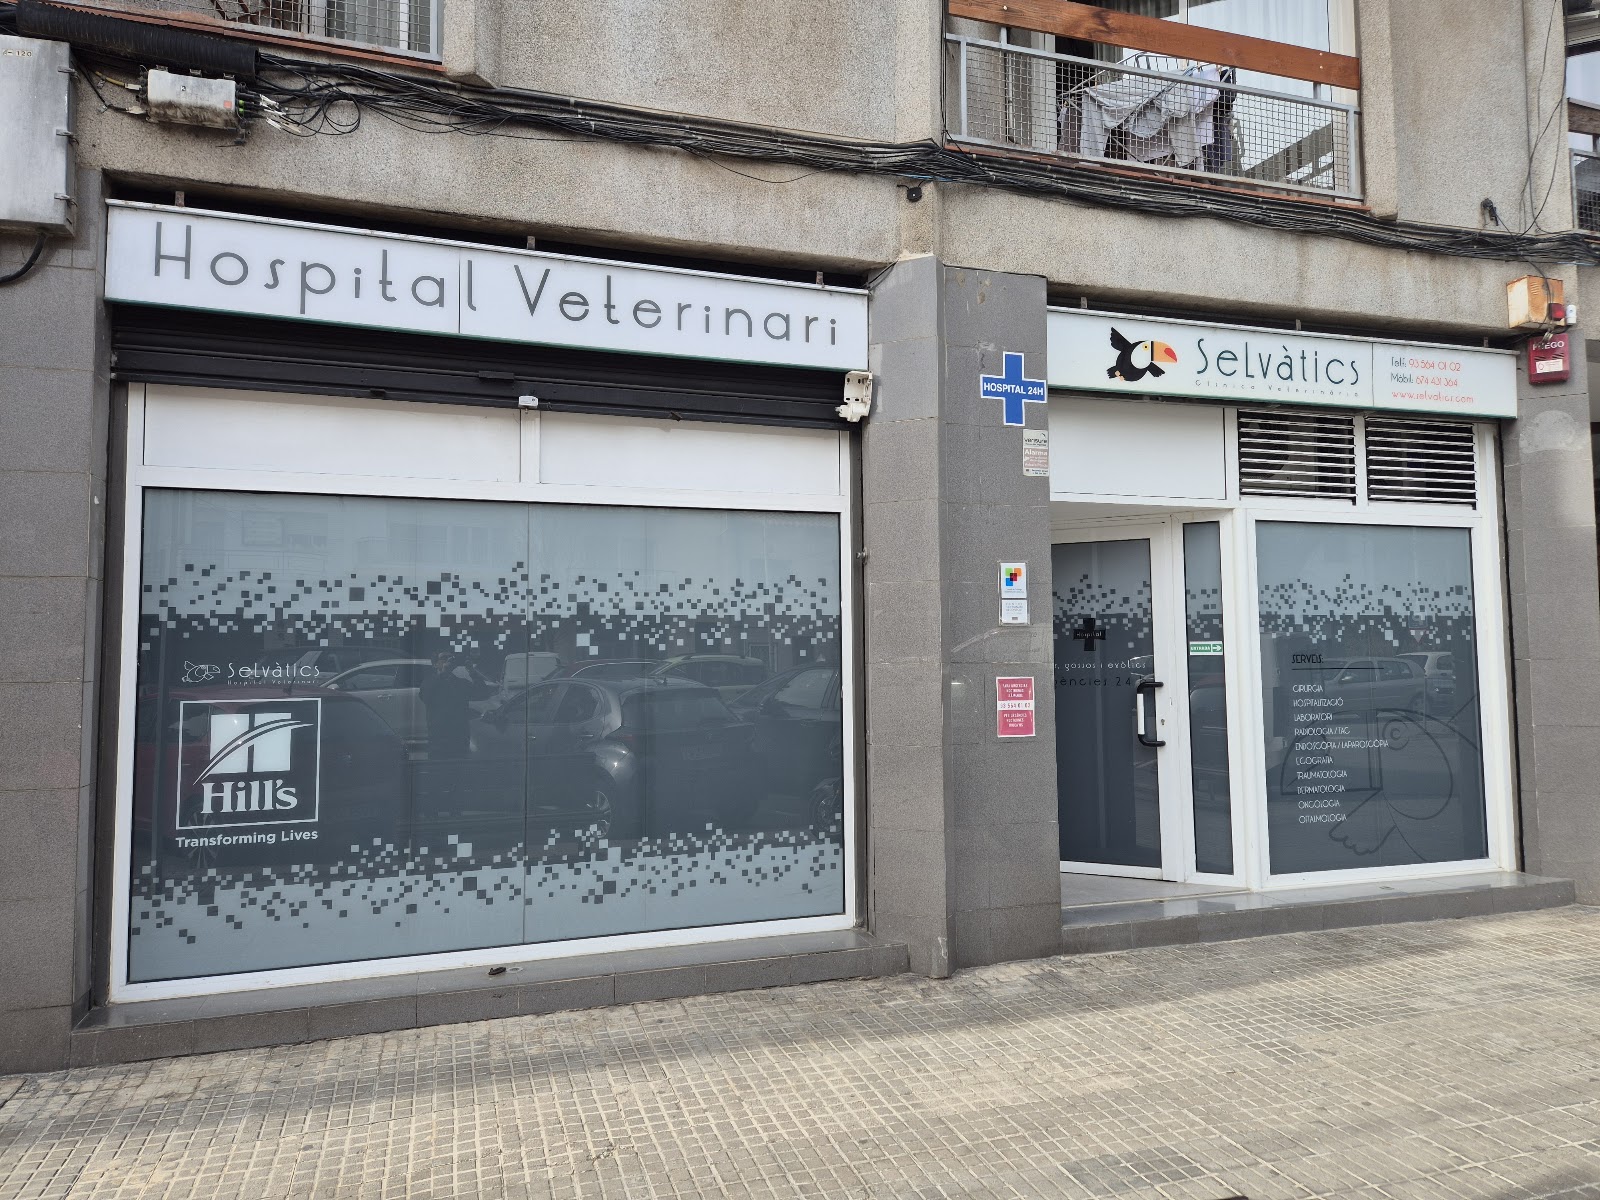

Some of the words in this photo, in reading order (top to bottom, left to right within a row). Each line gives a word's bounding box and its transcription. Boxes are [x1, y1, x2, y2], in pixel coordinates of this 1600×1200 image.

[154, 222, 477, 314] Hospital
[513, 265, 837, 345] Veterinari
[1408, 358, 1420, 369] 93
[1420, 359, 1435, 370] 564
[1437, 361, 1447, 371] 01
[1449, 361, 1461, 372] 02
[983, 382, 1026, 395] HOSPITAL
[1027, 386, 1044, 396] 24H
[1024, 448, 1048, 456] Alarma
[1291, 654, 1324, 664] SERVEIS:
[1064, 662, 1096, 672] gossos
[1292, 684, 1324, 693] CIRURGIA
[1293, 712, 1333, 722] LABORATORI
[1296, 769, 1348, 780] TRAUMATOLOGIA
[1297, 785, 1346, 795] DERMATOLOGIA
[200, 779, 298, 814] Hill's
[1298, 799, 1340, 809] ONCOLOGIA
[175, 831, 276, 848] Transforming
[281, 829, 319, 842] Lives
